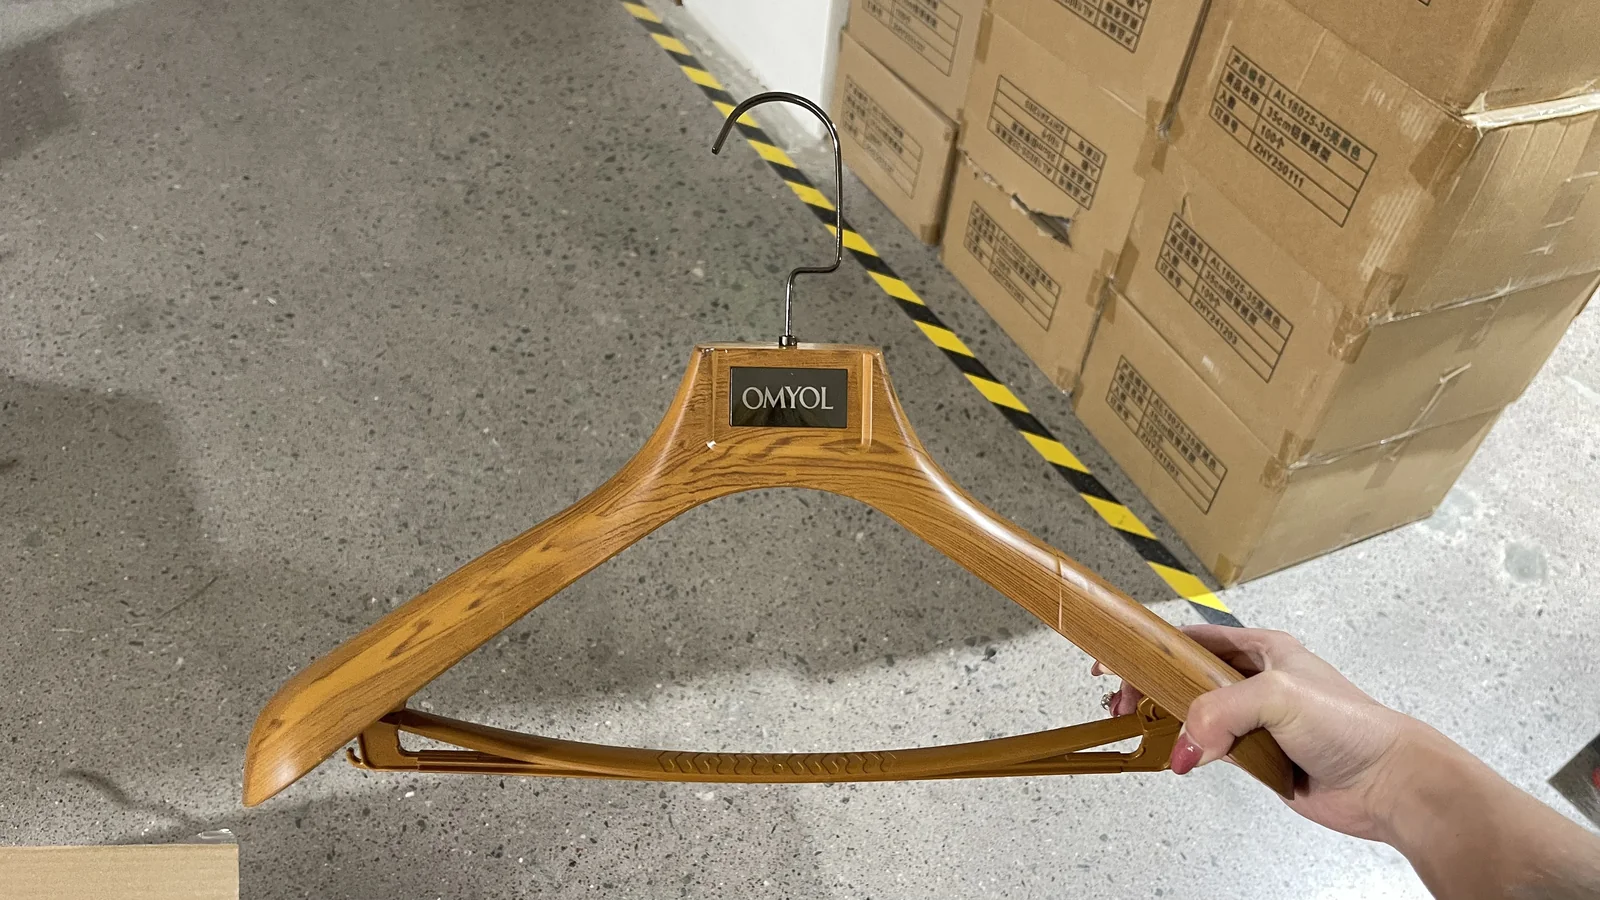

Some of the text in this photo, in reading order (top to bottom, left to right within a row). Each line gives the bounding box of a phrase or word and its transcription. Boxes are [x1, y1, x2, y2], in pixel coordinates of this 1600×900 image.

[1252, 141, 1304, 188] ZHY250111
[1173, 221, 1203, 253] 产品号
[742, 386, 834, 410] OMYOL
